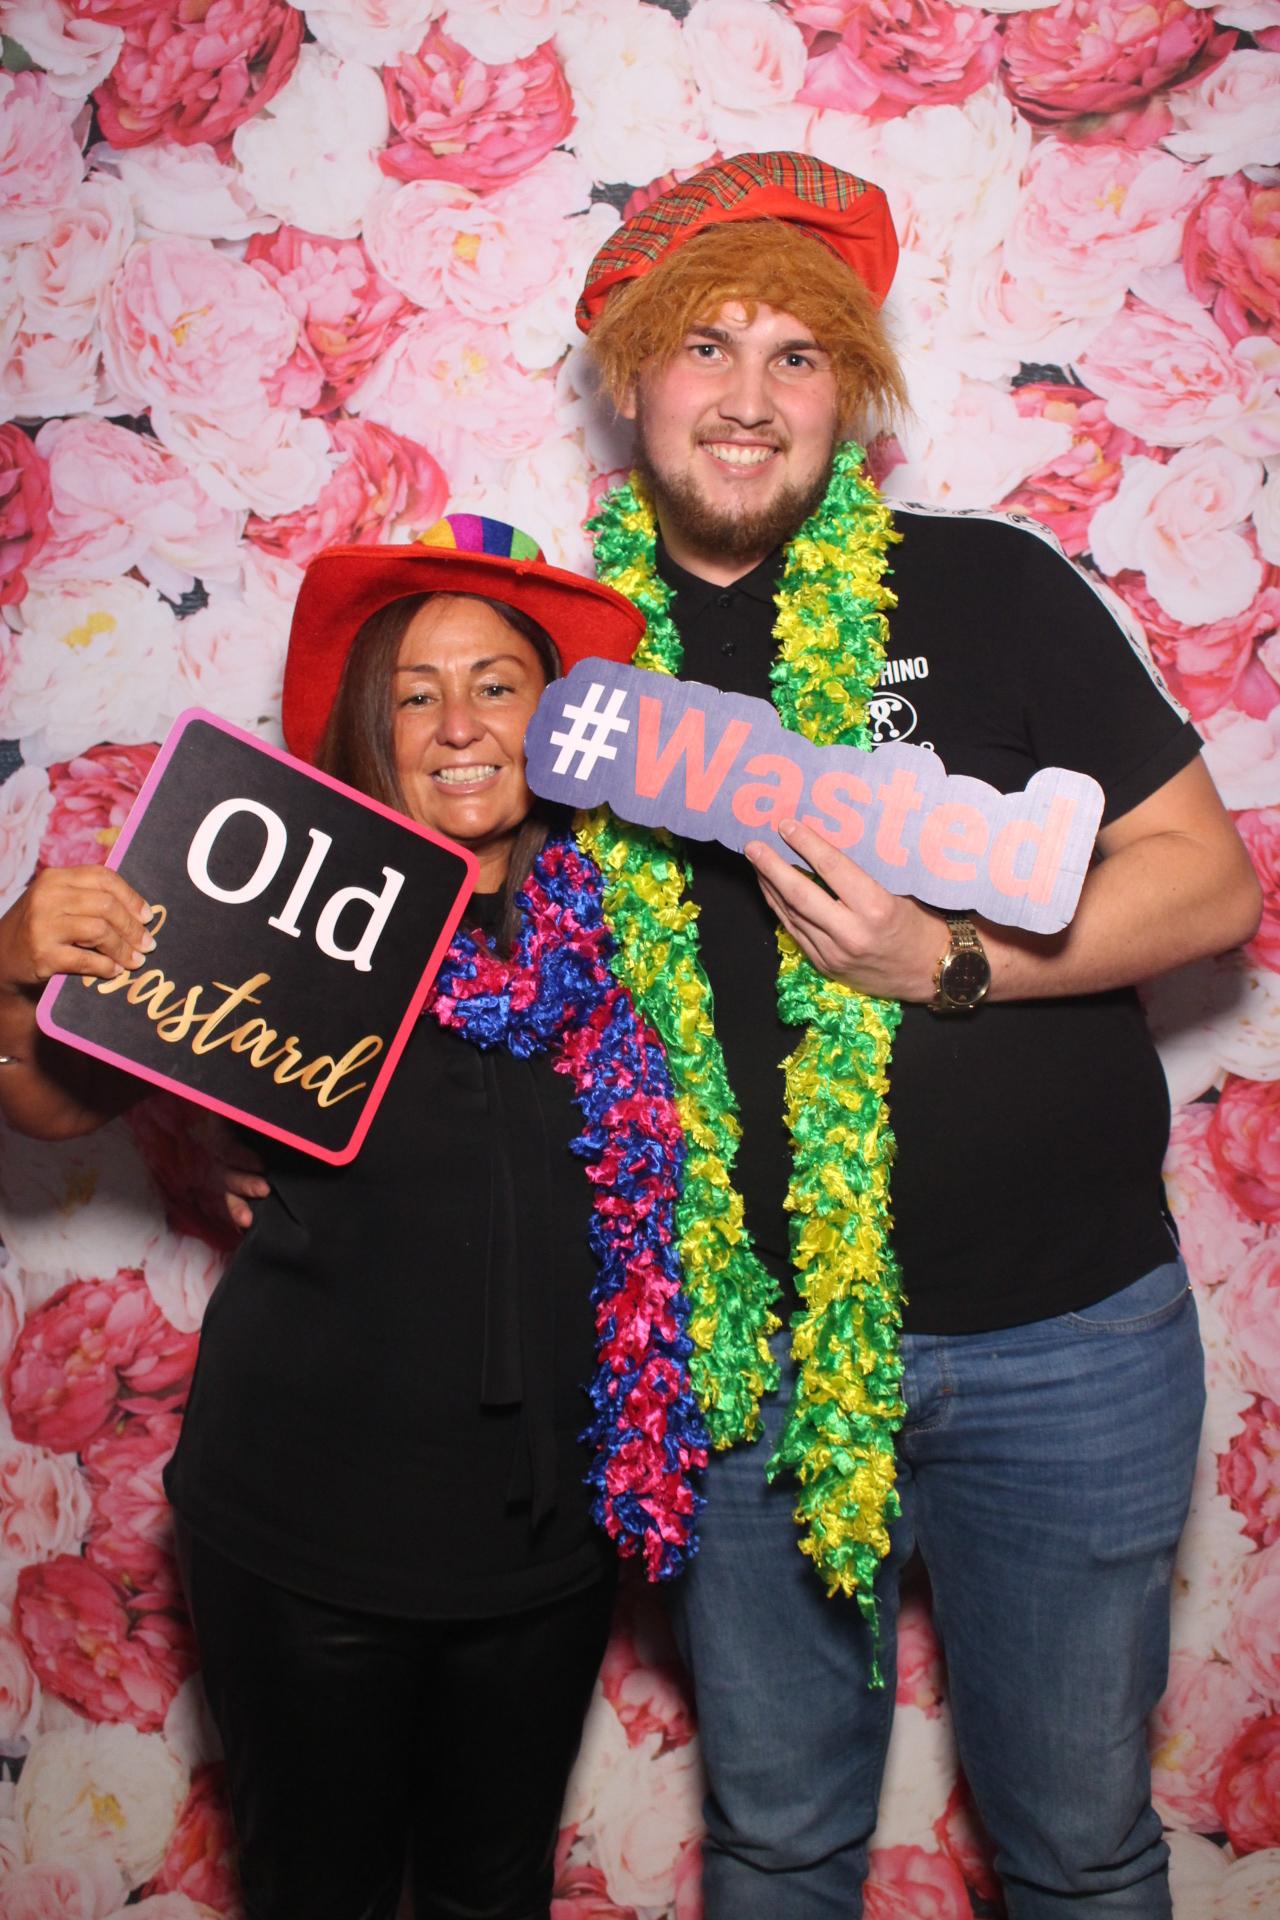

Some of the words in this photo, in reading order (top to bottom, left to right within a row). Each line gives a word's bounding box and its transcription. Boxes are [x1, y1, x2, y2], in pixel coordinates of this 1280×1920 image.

[878, 656, 929, 686] HINO
[550, 682, 1077, 904] #Wasted
[187, 797, 405, 972] Old
